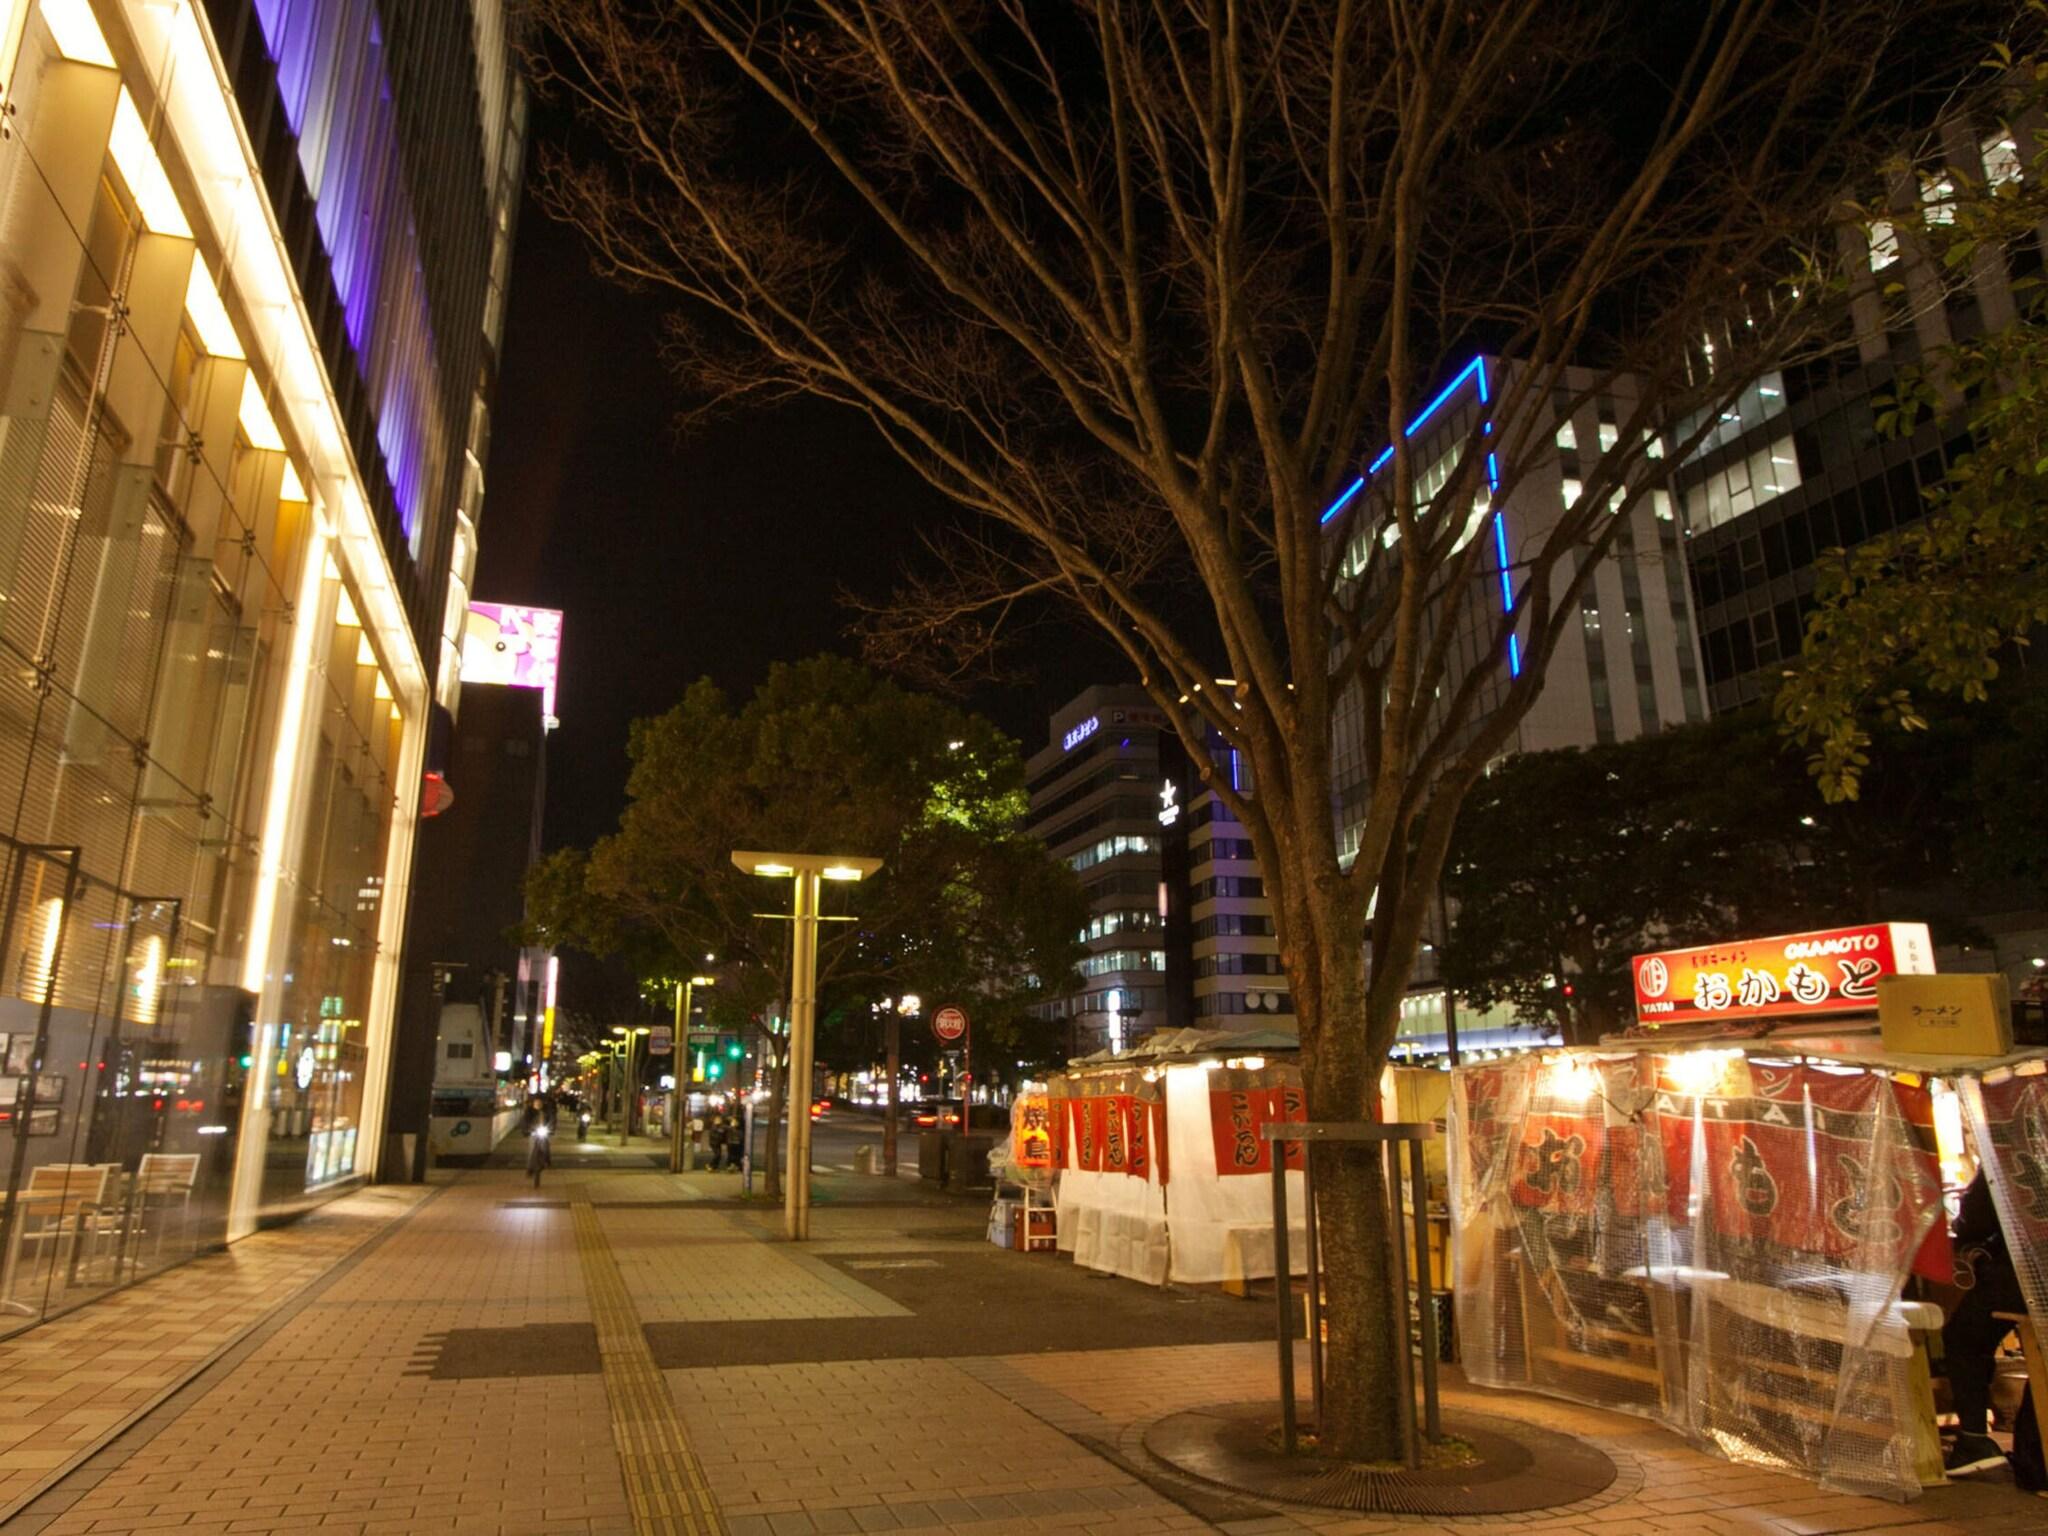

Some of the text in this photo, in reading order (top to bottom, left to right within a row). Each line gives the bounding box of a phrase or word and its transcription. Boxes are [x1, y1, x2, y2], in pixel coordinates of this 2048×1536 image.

[1784, 934, 1879, 960] OKAMOTO
[1694, 958, 1880, 1010] おかもと
[1642, 1001, 1675, 1014] YATAI
[1911, 1004, 1962, 1016] ラーメン
